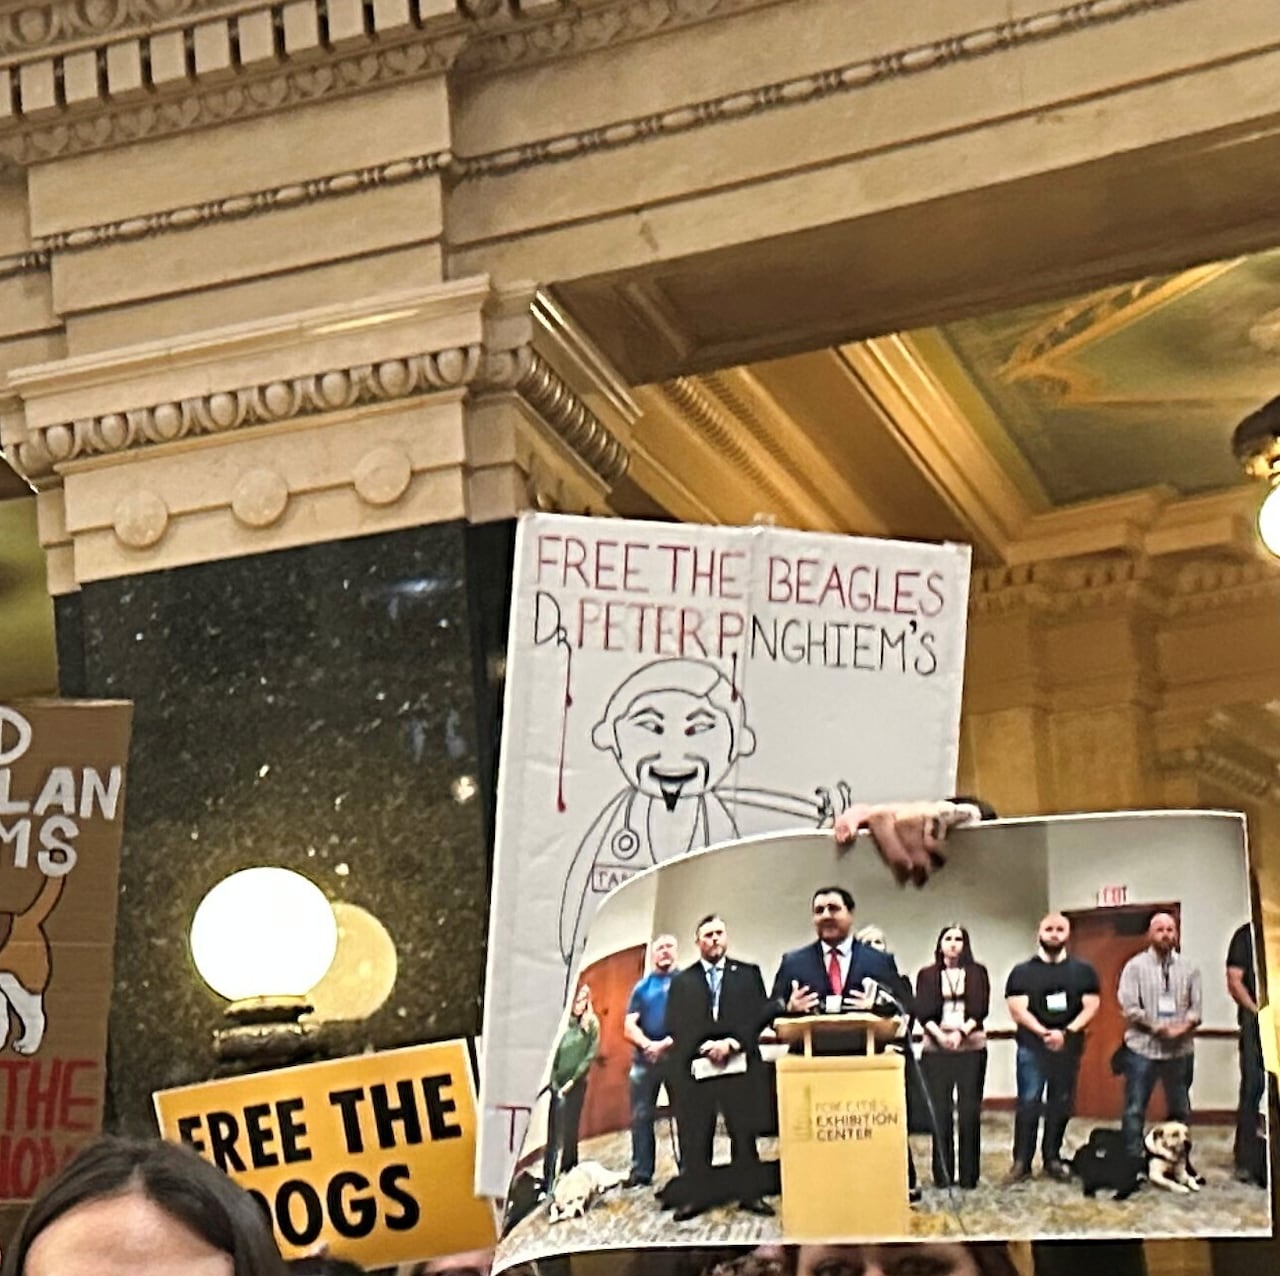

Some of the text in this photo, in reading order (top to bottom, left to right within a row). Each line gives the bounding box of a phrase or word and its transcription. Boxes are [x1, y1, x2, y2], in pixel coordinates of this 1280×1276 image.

[537, 535, 945, 618] FREE THE BEAGLES
[577, 598, 709, 658] PETER
[750, 614, 937, 676] NGHIEM'S
[329, 1072, 462, 1155] THE
